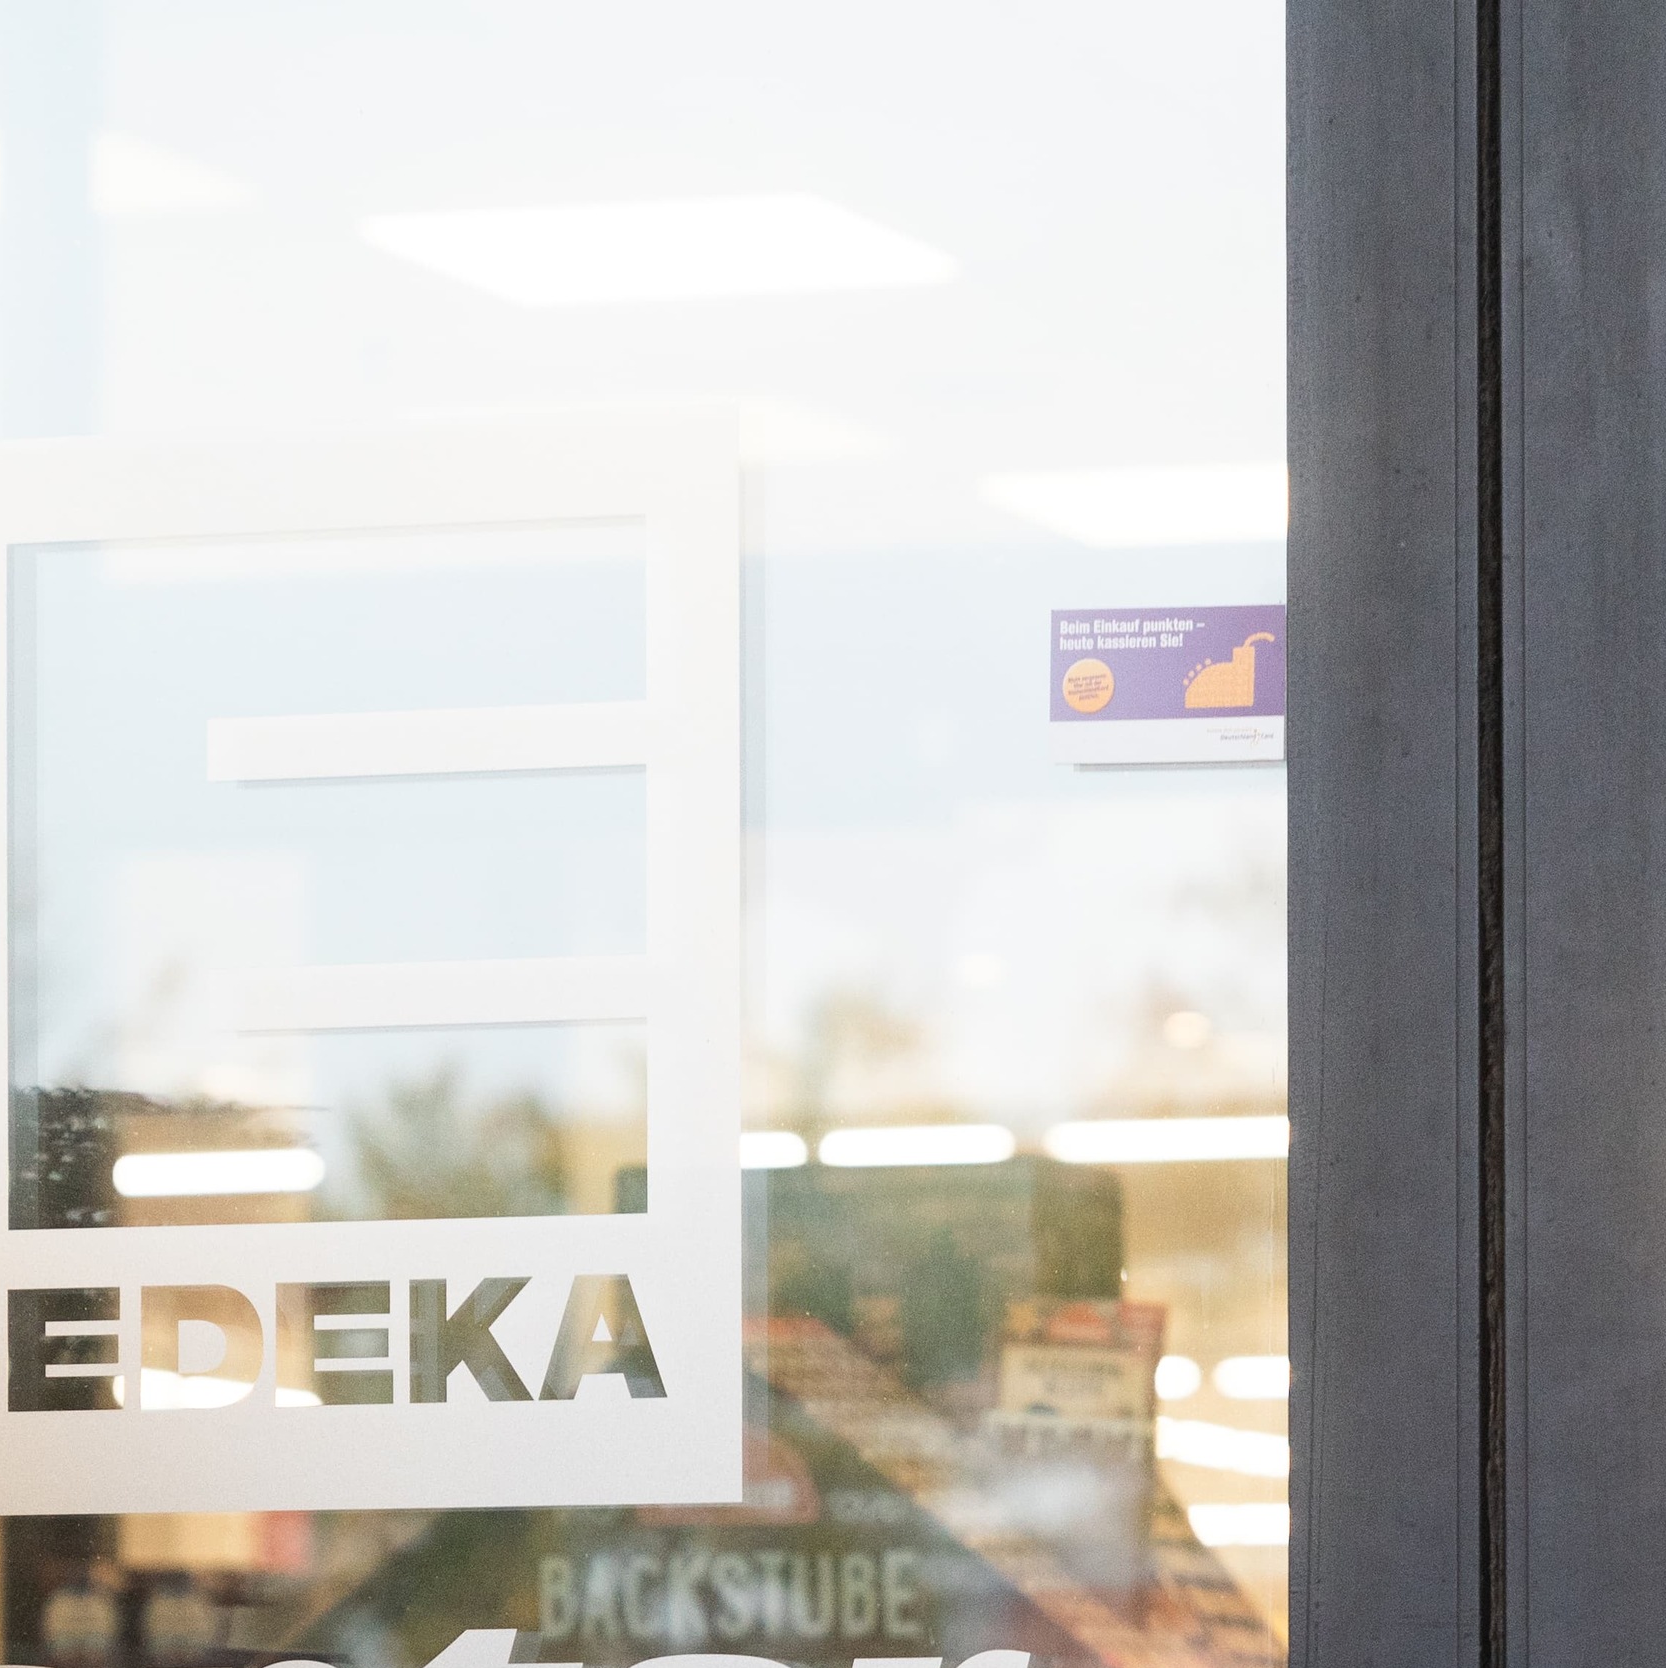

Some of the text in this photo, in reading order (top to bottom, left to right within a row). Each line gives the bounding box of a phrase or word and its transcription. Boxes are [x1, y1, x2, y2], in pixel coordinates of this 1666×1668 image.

[1059, 633, 1183, 650] heute kassieren Sie!
[1060, 619, 1090, 634] Beim
[1093, 618, 1140, 634] Einkauf
[1143, 617, 1193, 635] punkten
[6, 1273, 668, 1413] EDEKA
[538, 1547, 925, 1646] BACKSTUBE
